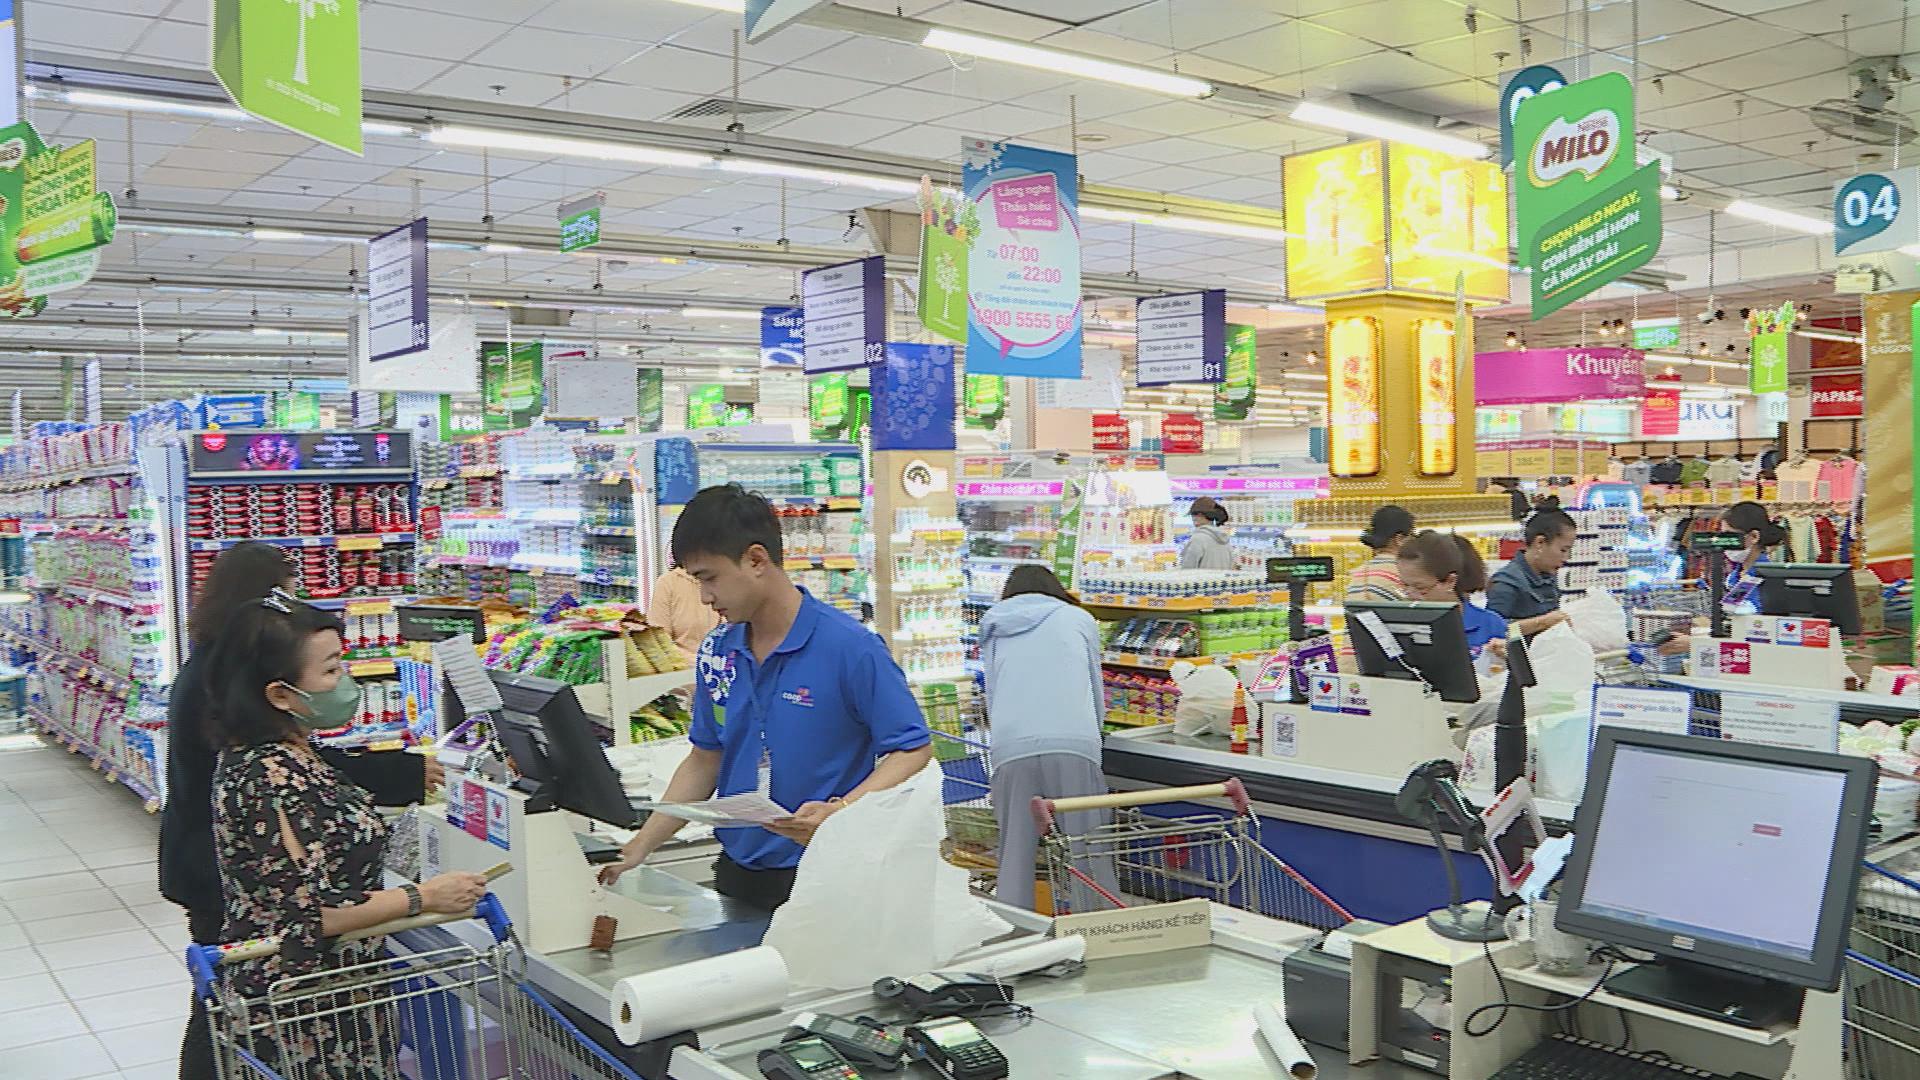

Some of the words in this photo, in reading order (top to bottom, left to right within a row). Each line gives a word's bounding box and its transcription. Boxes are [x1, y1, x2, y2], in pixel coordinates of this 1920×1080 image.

[1541, 129, 1609, 168] MILO
[25, 175, 62, 202] CHỨNG
[63, 162, 91, 183] MINH
[1026, 185, 1051, 197] nghe
[25, 193, 63, 219] KHOA
[1844, 185, 1897, 227] 04
[1032, 217, 1053, 226] chia
[1541, 226, 1573, 253] CHỌN
[1574, 211, 1603, 236] MILO
[1542, 249, 1568, 272] CON
[1610, 209, 1640, 236] HƠN
[1000, 243, 1039, 263] 07:00
[1023, 265, 1061, 284] 22:00
[1560, 255, 1594, 283] NGÀY
[976, 309, 1011, 328] 1900
[1016, 311, 1051, 330] 5555
[1055, 314, 1073, 332] 68
[413, 323, 426, 347] 03
[866, 342, 884, 363] 02
[1871, 344, 1913, 355] SAIGON
[1205, 362, 1220, 380] 01
[1566, 350, 1639, 379] Khuyến
[1090, 921, 1129, 937] KHÁCH
[1131, 918, 1163, 932] HÀNG
[1165, 914, 1180, 928] KẾ
[1182, 912, 1207, 926] TIẾP
